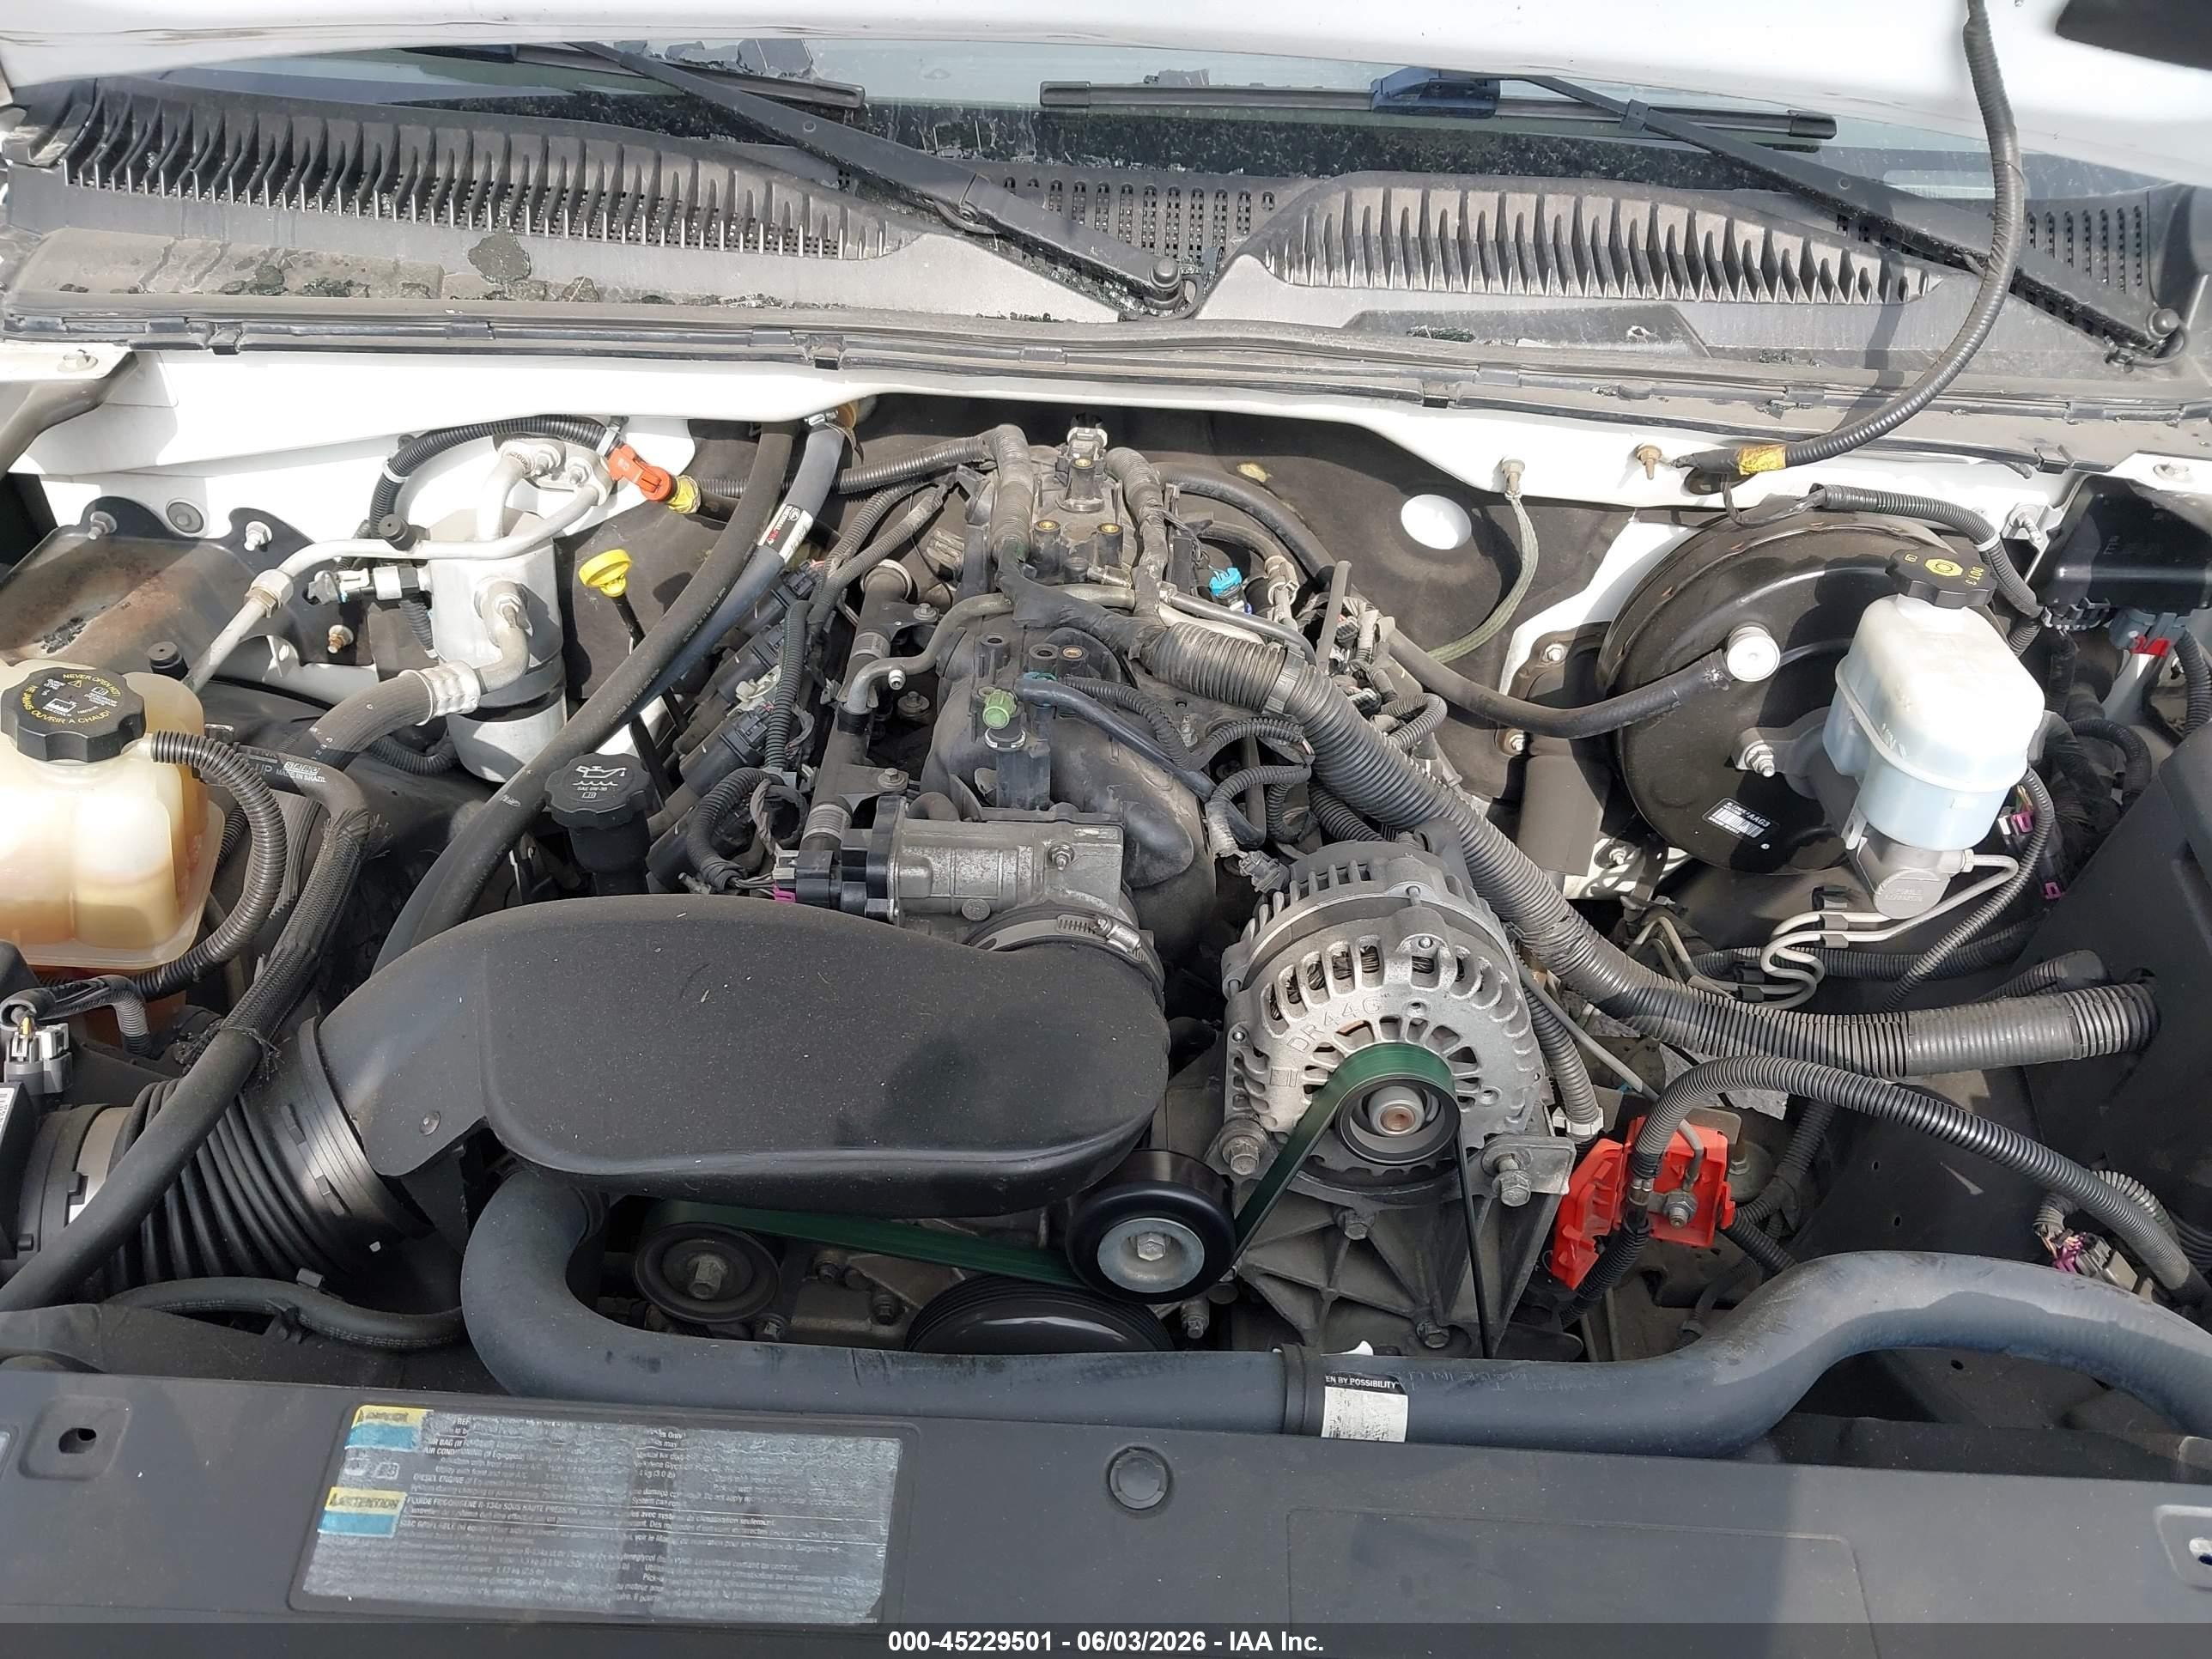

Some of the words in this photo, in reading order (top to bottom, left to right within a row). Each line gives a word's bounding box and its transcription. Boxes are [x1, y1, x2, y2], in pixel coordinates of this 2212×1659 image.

[92, 677, 109, 688] OPEN
[31, 710, 66, 725] OUVRIR
[276, 769, 295, 778] MADE
[303, 774, 327, 783] BRAZIL
[1349, 1378, 1396, 1389] POSSIBILITY
